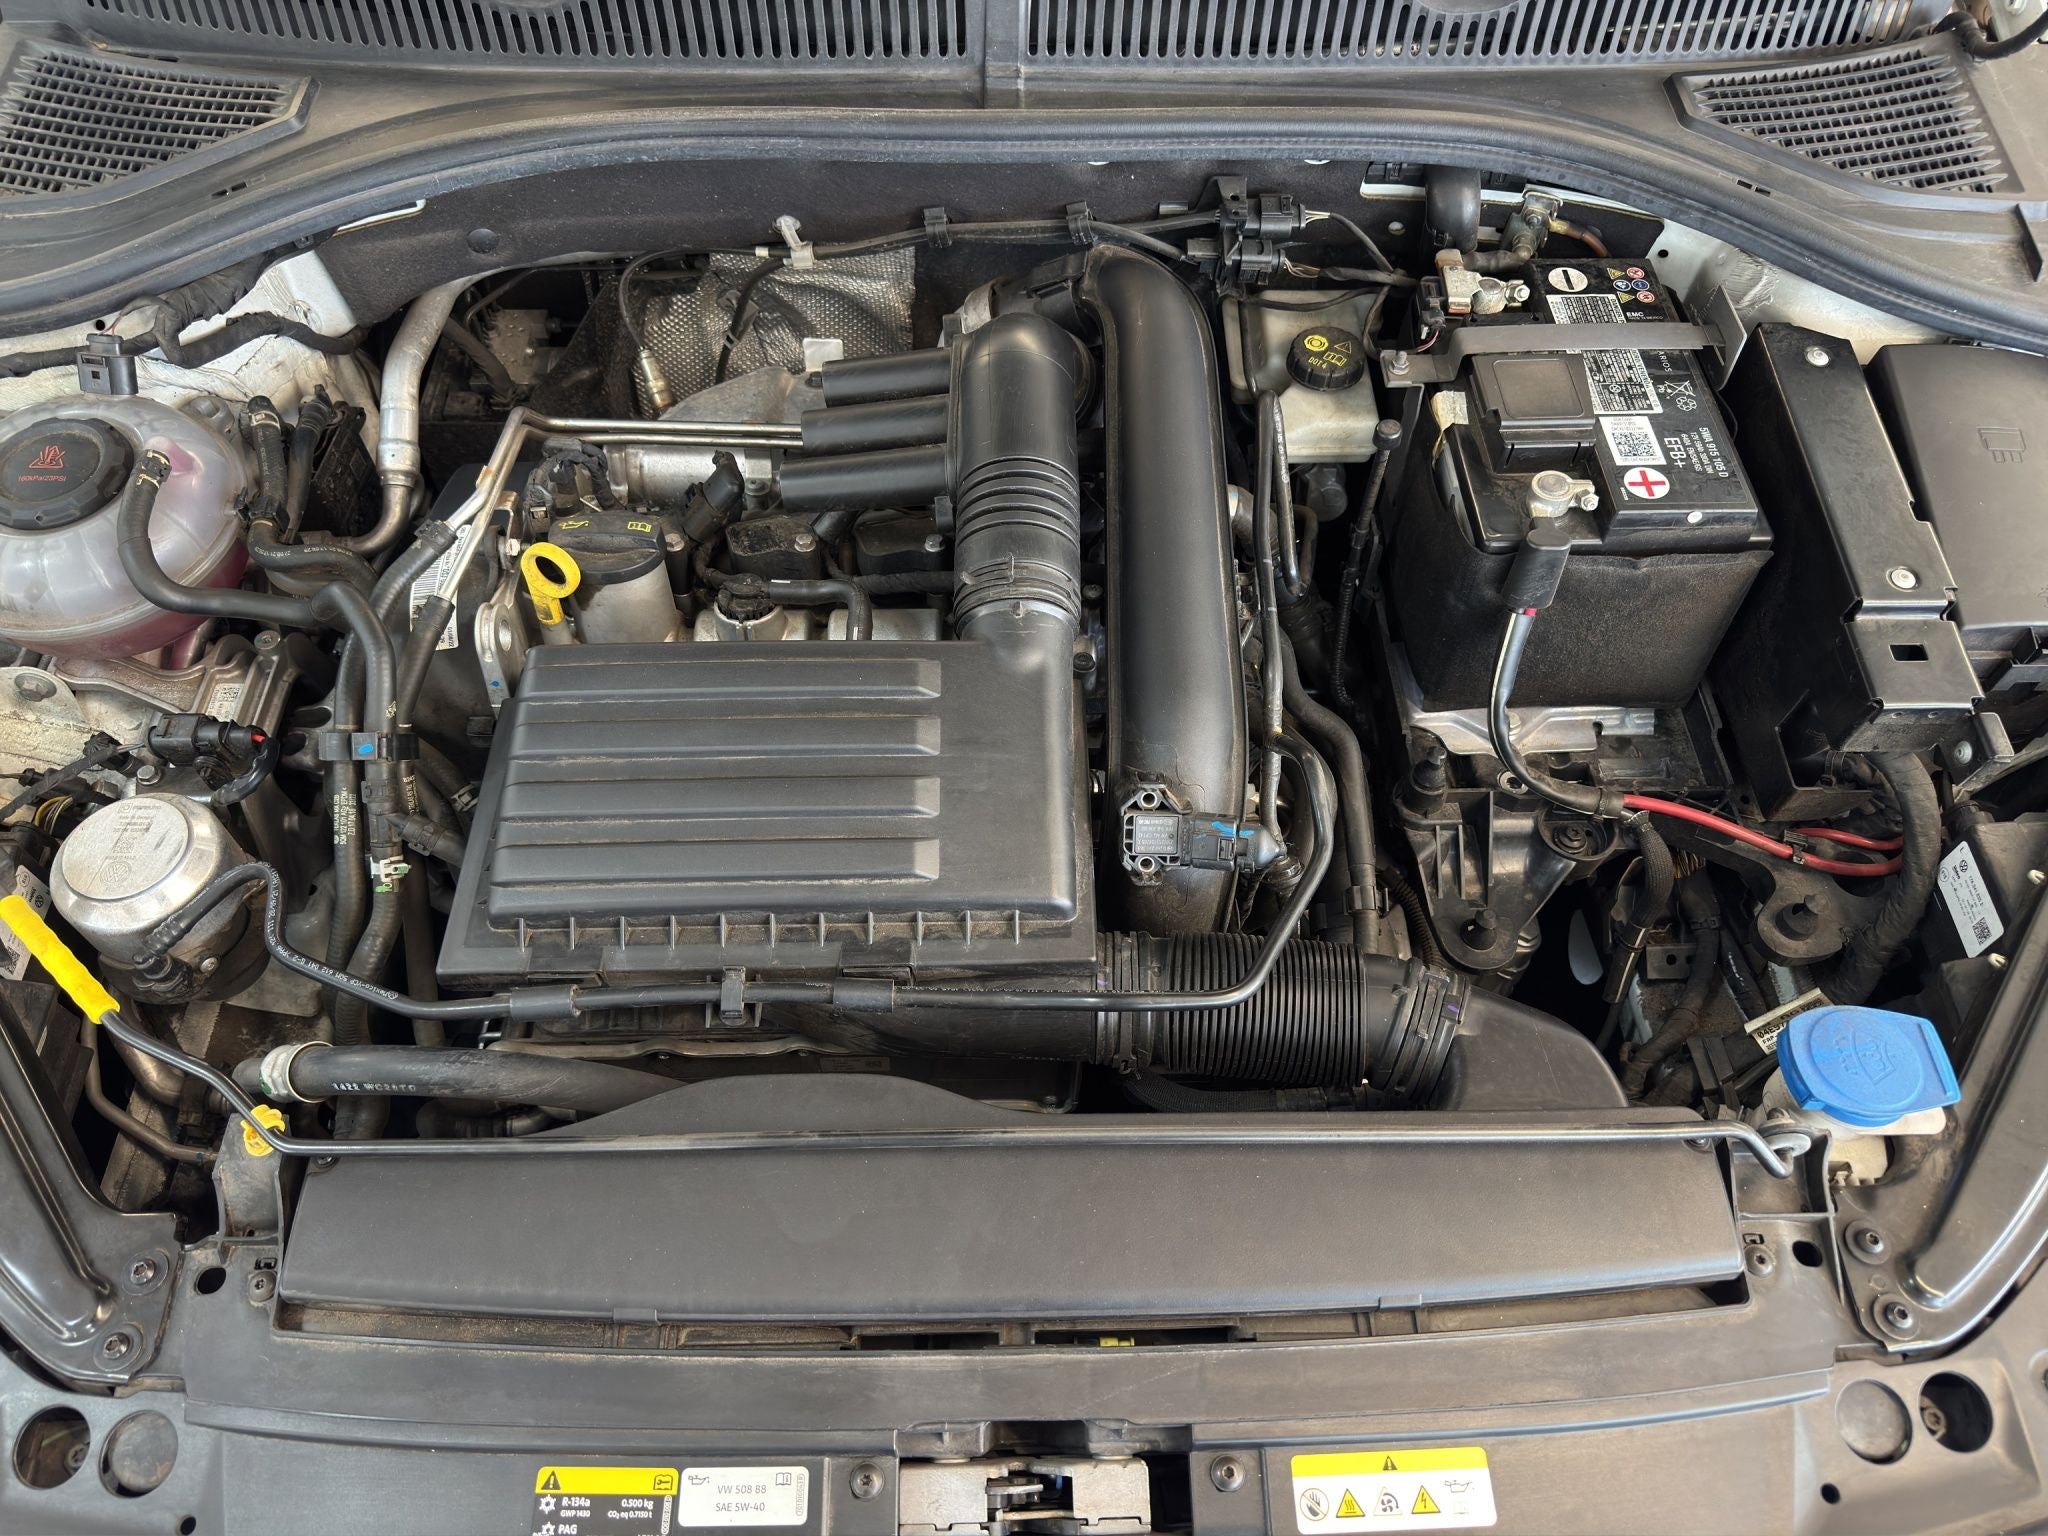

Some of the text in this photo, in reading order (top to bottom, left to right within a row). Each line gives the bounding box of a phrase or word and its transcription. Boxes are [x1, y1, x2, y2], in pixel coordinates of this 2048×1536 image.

[1308, 356, 1328, 370] DOT 4
[1657, 350, 1673, 372] ARIOS
[1657, 384, 1665, 393] Pb
[1699, 427, 1714, 443] 5WA
[1664, 437, 1687, 468] EFB+
[1706, 443, 1720, 457] 915
[1713, 457, 1727, 471] 105
[717, 1484, 767, 1494] VW 508 88
[561, 1496, 654, 1510] R-134a 0.500 kg
[715, 1502, 766, 1512] SAE 5W-40
[620, 1511, 629, 1519] eq
[629, 1510, 649, 1518] 0.7150
[558, 1524, 578, 1534] PAG
